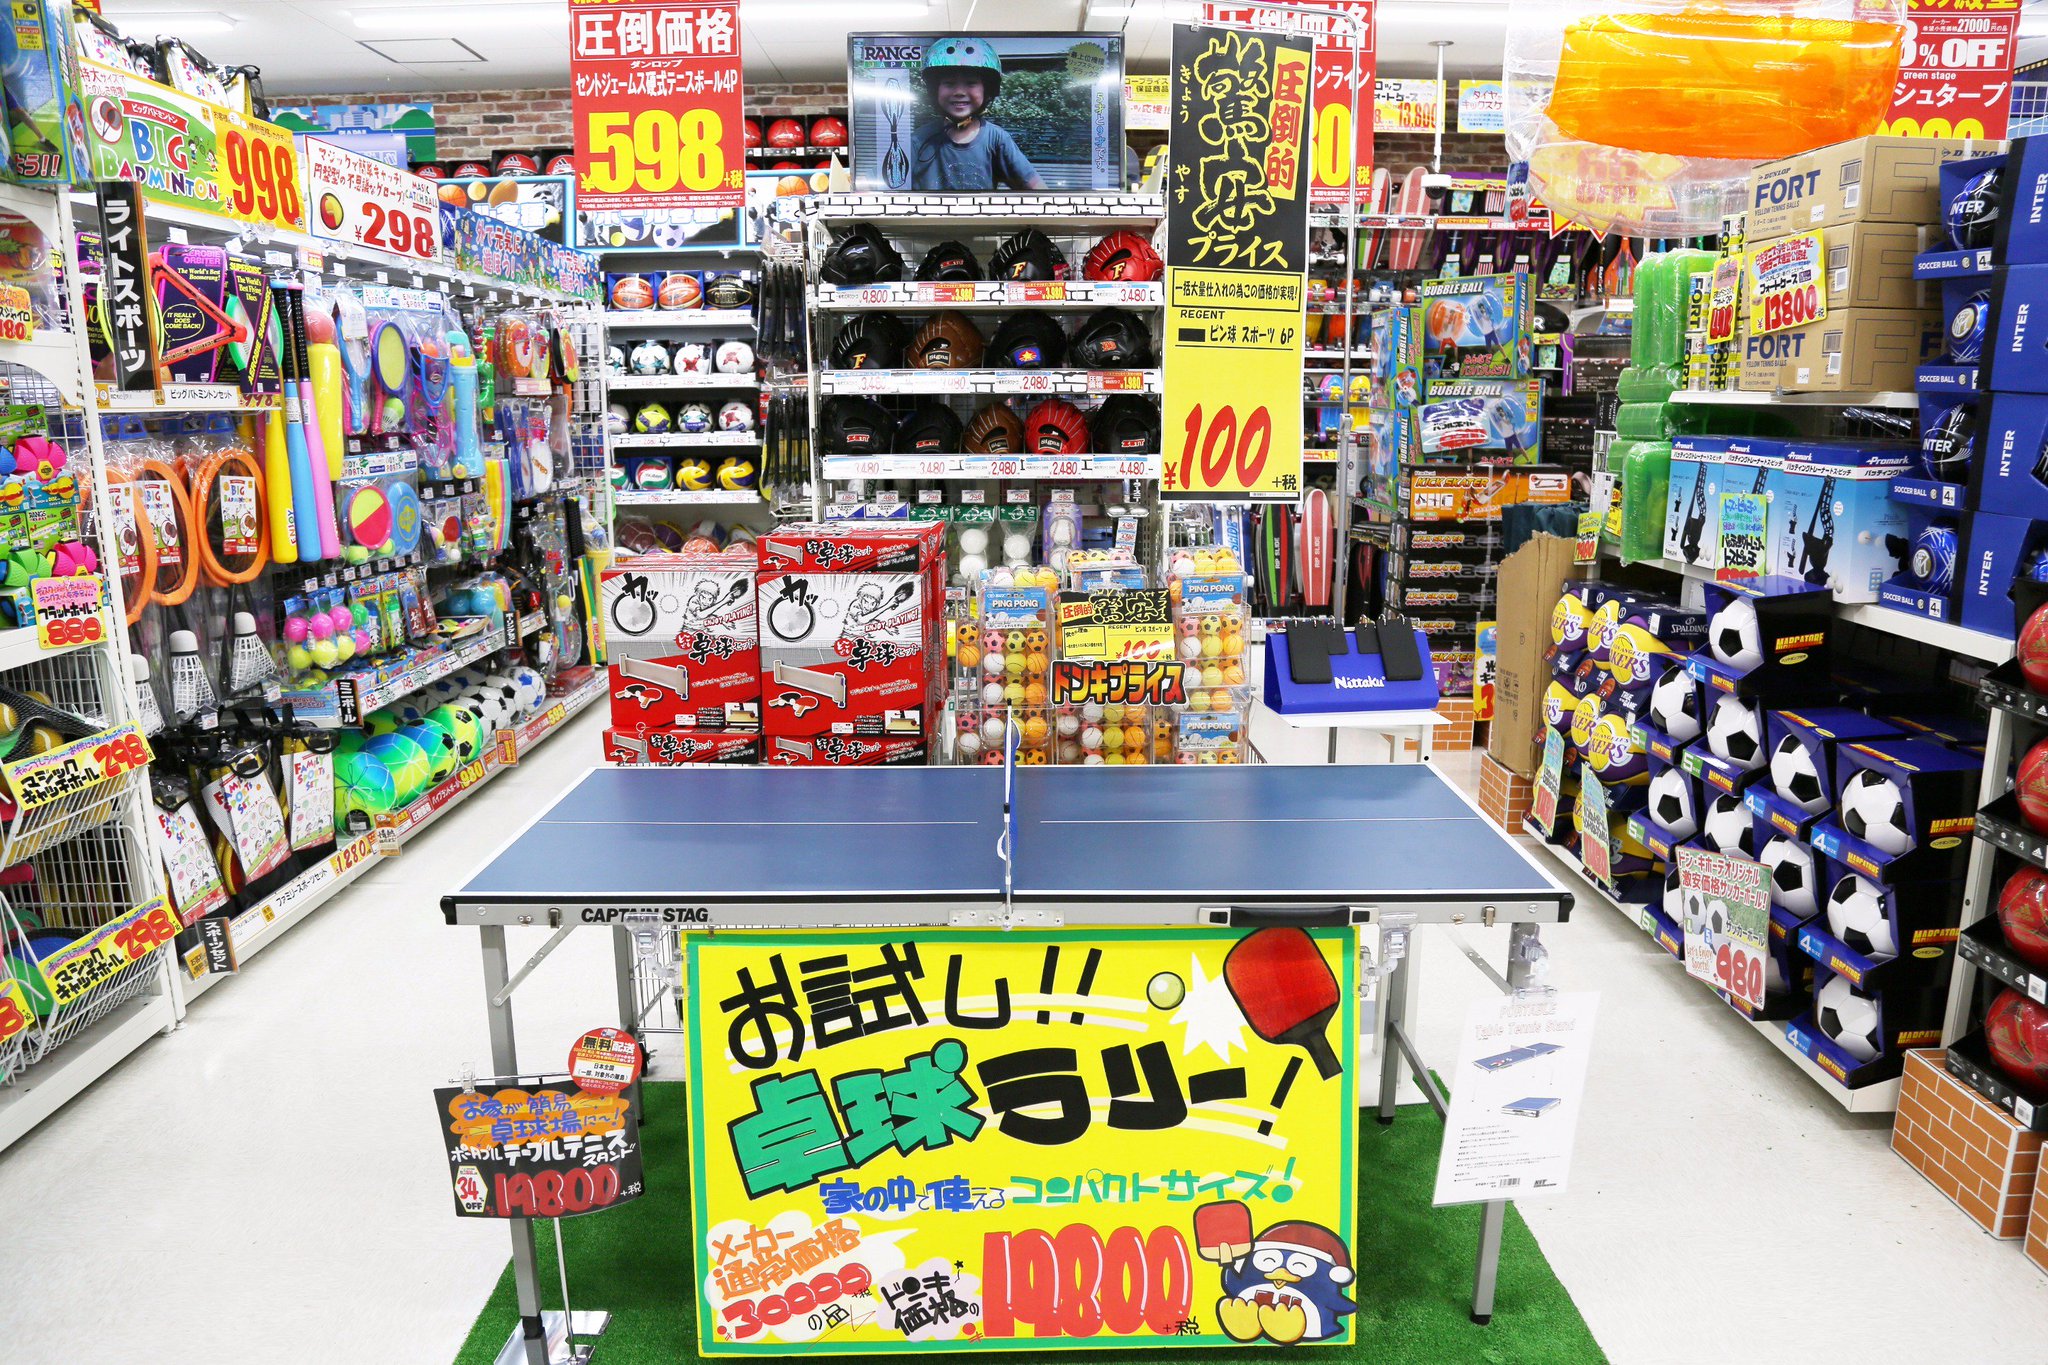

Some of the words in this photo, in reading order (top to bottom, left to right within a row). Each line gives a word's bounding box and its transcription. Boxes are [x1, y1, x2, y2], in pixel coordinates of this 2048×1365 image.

[577, 8, 734, 56] 圧倒価格
[865, 46, 920, 60] RANGS
[1941, 38, 2006, 68] OFF
[630, 59, 682, 69] ダンロップ
[1904, 72, 1928, 80] green
[1931, 72, 1957, 80] stage
[1266, 61, 1306, 190] 圧倒的
[130, 118, 189, 173] BIG
[99, 146, 218, 201] BADMINTON
[1755, 169, 1821, 208] FORT
[2029, 172, 2048, 223] INTER
[1771, 203, 1785, 214] TENNIS
[1786, 200, 1800, 210] BALLS
[1188, 231, 1288, 268] プライス
[1918, 261, 1941, 270] SOCCER
[1942, 260, 1958, 269] BALL
[104, 200, 146, 373] ライトスポーツ
[1424, 283, 1460, 297] BUBBLE
[1460, 281, 1483, 294] BALL
[1692, 278, 1703, 328] FORT
[1180, 309, 1225, 320] REGENT
[1210, 325, 1237, 343] ピン球
[1242, 327, 1275, 344] スポーツ
[1280, 328, 1294, 345] 6P
[2012, 303, 2030, 352] INTER
[1747, 333, 1806, 359] FORT
[1023, 376, 1048, 390] 2,980
[1919, 375, 1940, 383] SOCCER
[1941, 375, 1955, 383] BALL
[1429, 385, 1474, 396] BUBBLE
[1475, 385, 1500, 396] BALL
[1866, 456, 1910, 465] Promark
[2000, 430, 2015, 477] INTER
[991, 461, 1016, 475] 2,980
[1052, 461, 1077, 475] 2,480
[1119, 461, 1144, 475] 4,480
[1445, 476, 1490, 489] SKATER
[1894, 485, 1912, 495] SOCCER
[1912, 487, 1927, 497] BALL
[1979, 550, 1993, 596] INTER
[1189, 585, 1209, 593] PING
[1210, 584, 1234, 592] PONG
[992, 599, 1015, 608] PING
[1017, 599, 1038, 608] PONG
[1063, 604, 1093, 619] 圧倒的
[724, 604, 754, 623] PLAYING!
[865, 620, 887, 633] ENJOY
[888, 608, 919, 628] PLAYING!
[47, 617, 101, 645] 880
[1671, 624, 1708, 634] SPALDING
[1432, 651, 1476, 663] SKATER
[1053, 661, 1187, 704] ドンキプライス
[1334, 676, 1384, 689] Nittaku
[337, 680, 357, 727] ミニボール
[1187, 721, 1207, 730] PING
[1209, 721, 1232, 730] PONG
[94, 733, 148, 778] 298
[306, 779, 319, 791] SET
[663, 908, 709, 922] STAG
[114, 908, 175, 961] 298
[1716, 944, 1762, 1004] 980
[719, 941, 1102, 1070] お試し!!
[1499, 1002, 1558, 1018] PORTABLE
[1474, 1023, 1504, 1038] Table
[1508, 1021, 1541, 1036] Tennis
[1546, 1018, 1577, 1033] Stand
[465, 1202, 482, 1211] OFF
[712, 1218, 862, 1302] 通常価格
